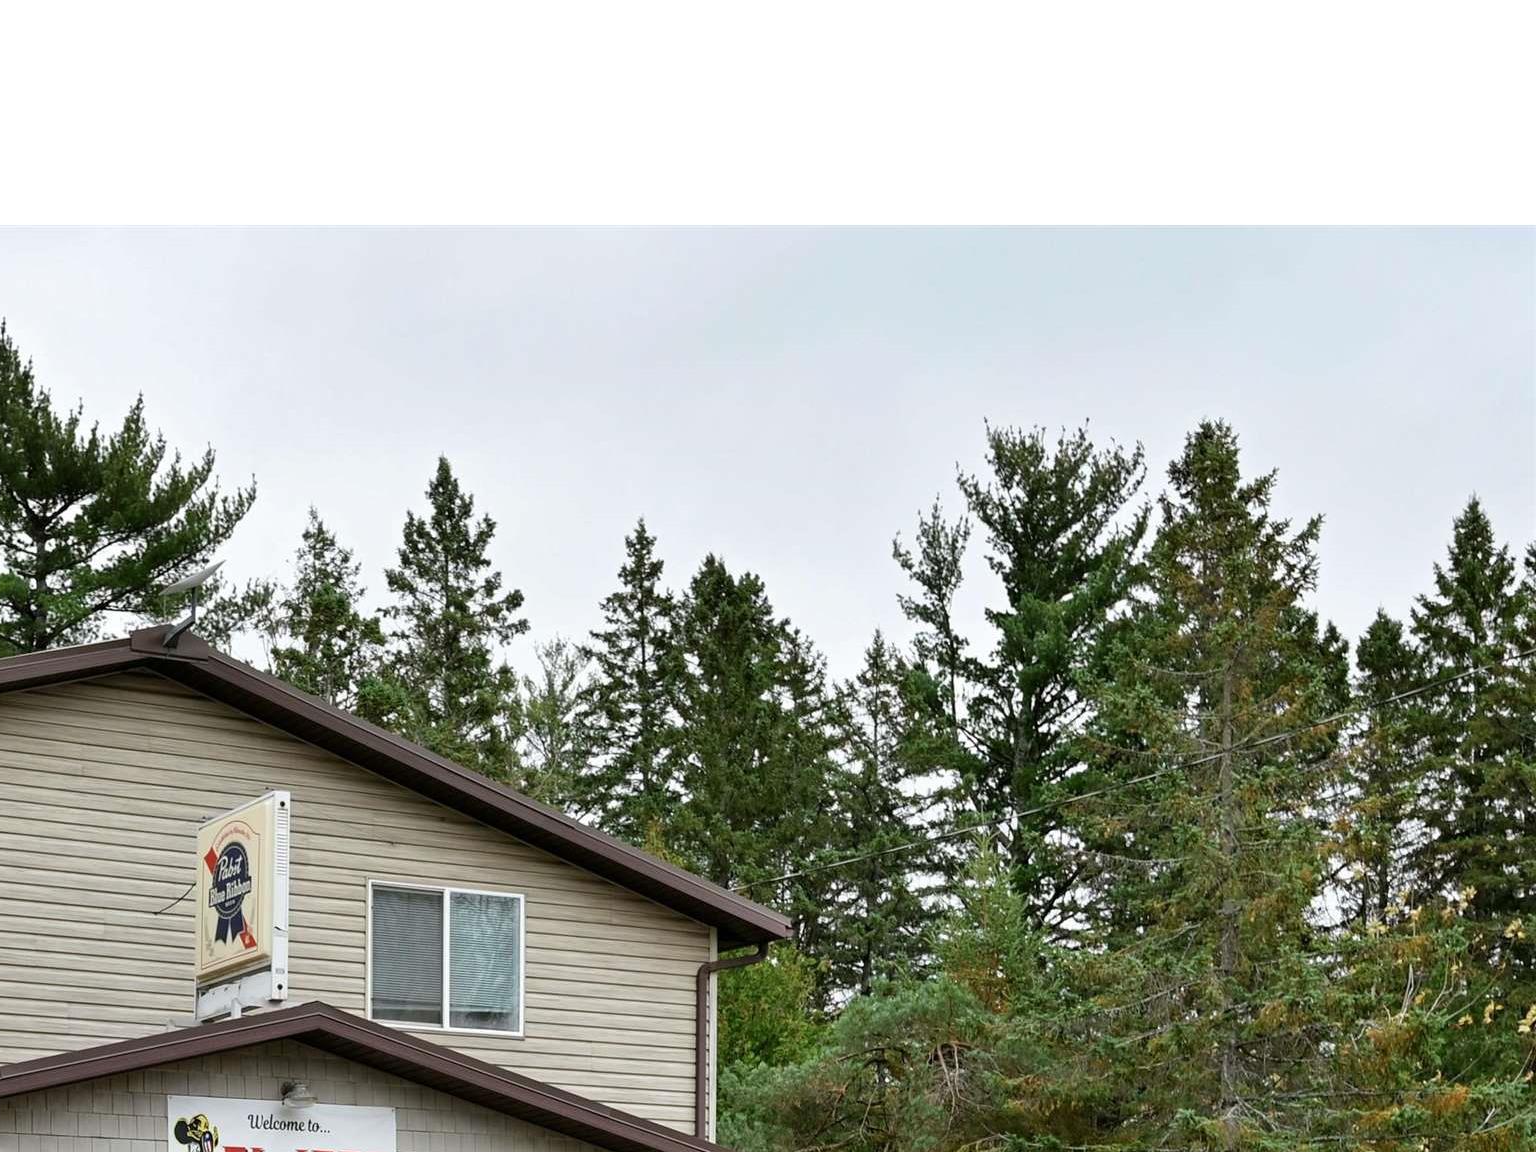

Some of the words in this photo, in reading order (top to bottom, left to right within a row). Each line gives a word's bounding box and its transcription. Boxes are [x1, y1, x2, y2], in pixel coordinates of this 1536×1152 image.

[217, 855, 243, 882] Pabst
[210, 887, 226, 907] Blue
[226, 879, 251, 900] Ribbon
[247, 1113, 305, 1133] Welcome
